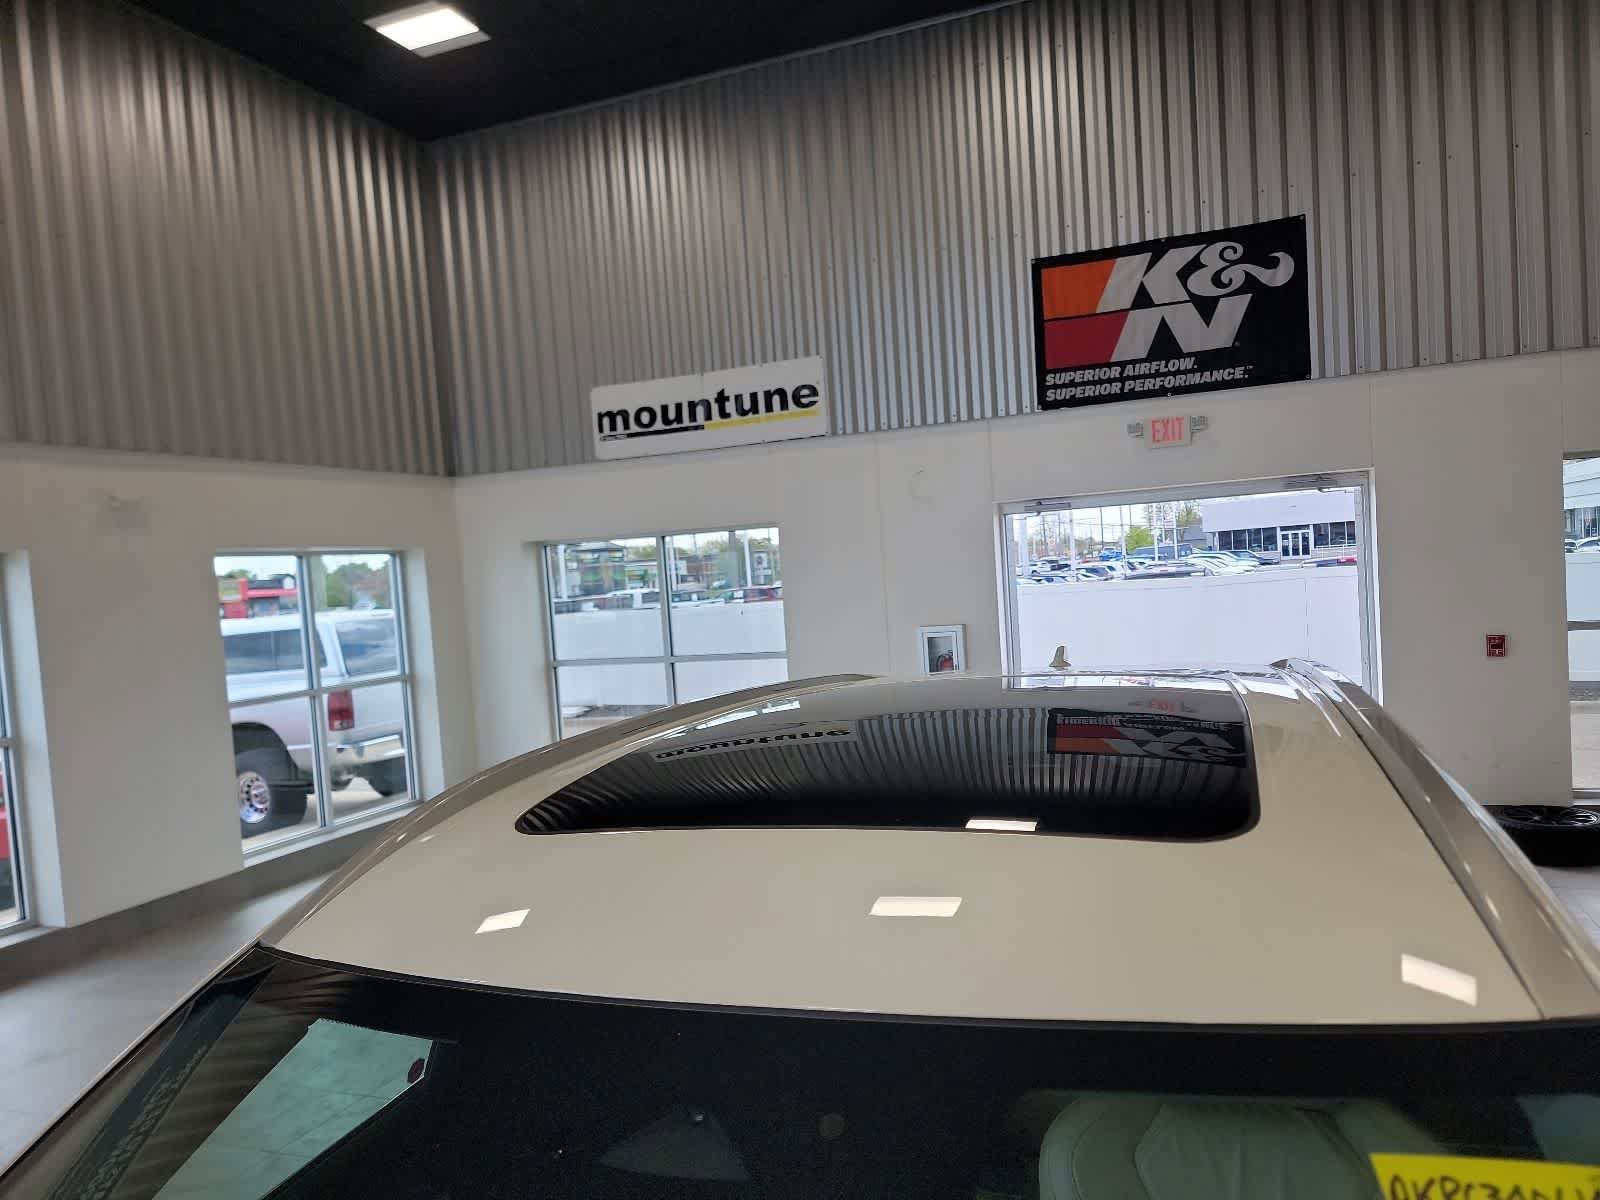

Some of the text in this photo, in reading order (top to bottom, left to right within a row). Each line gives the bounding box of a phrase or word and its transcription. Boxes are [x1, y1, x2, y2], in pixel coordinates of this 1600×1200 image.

[1045, 356, 1198, 386] SUPERIOR AIRFLOW.
[1045, 381, 1121, 401] SUPERIOR
[597, 383, 819, 433] mountune
[1151, 416, 1185, 444] EXIT
